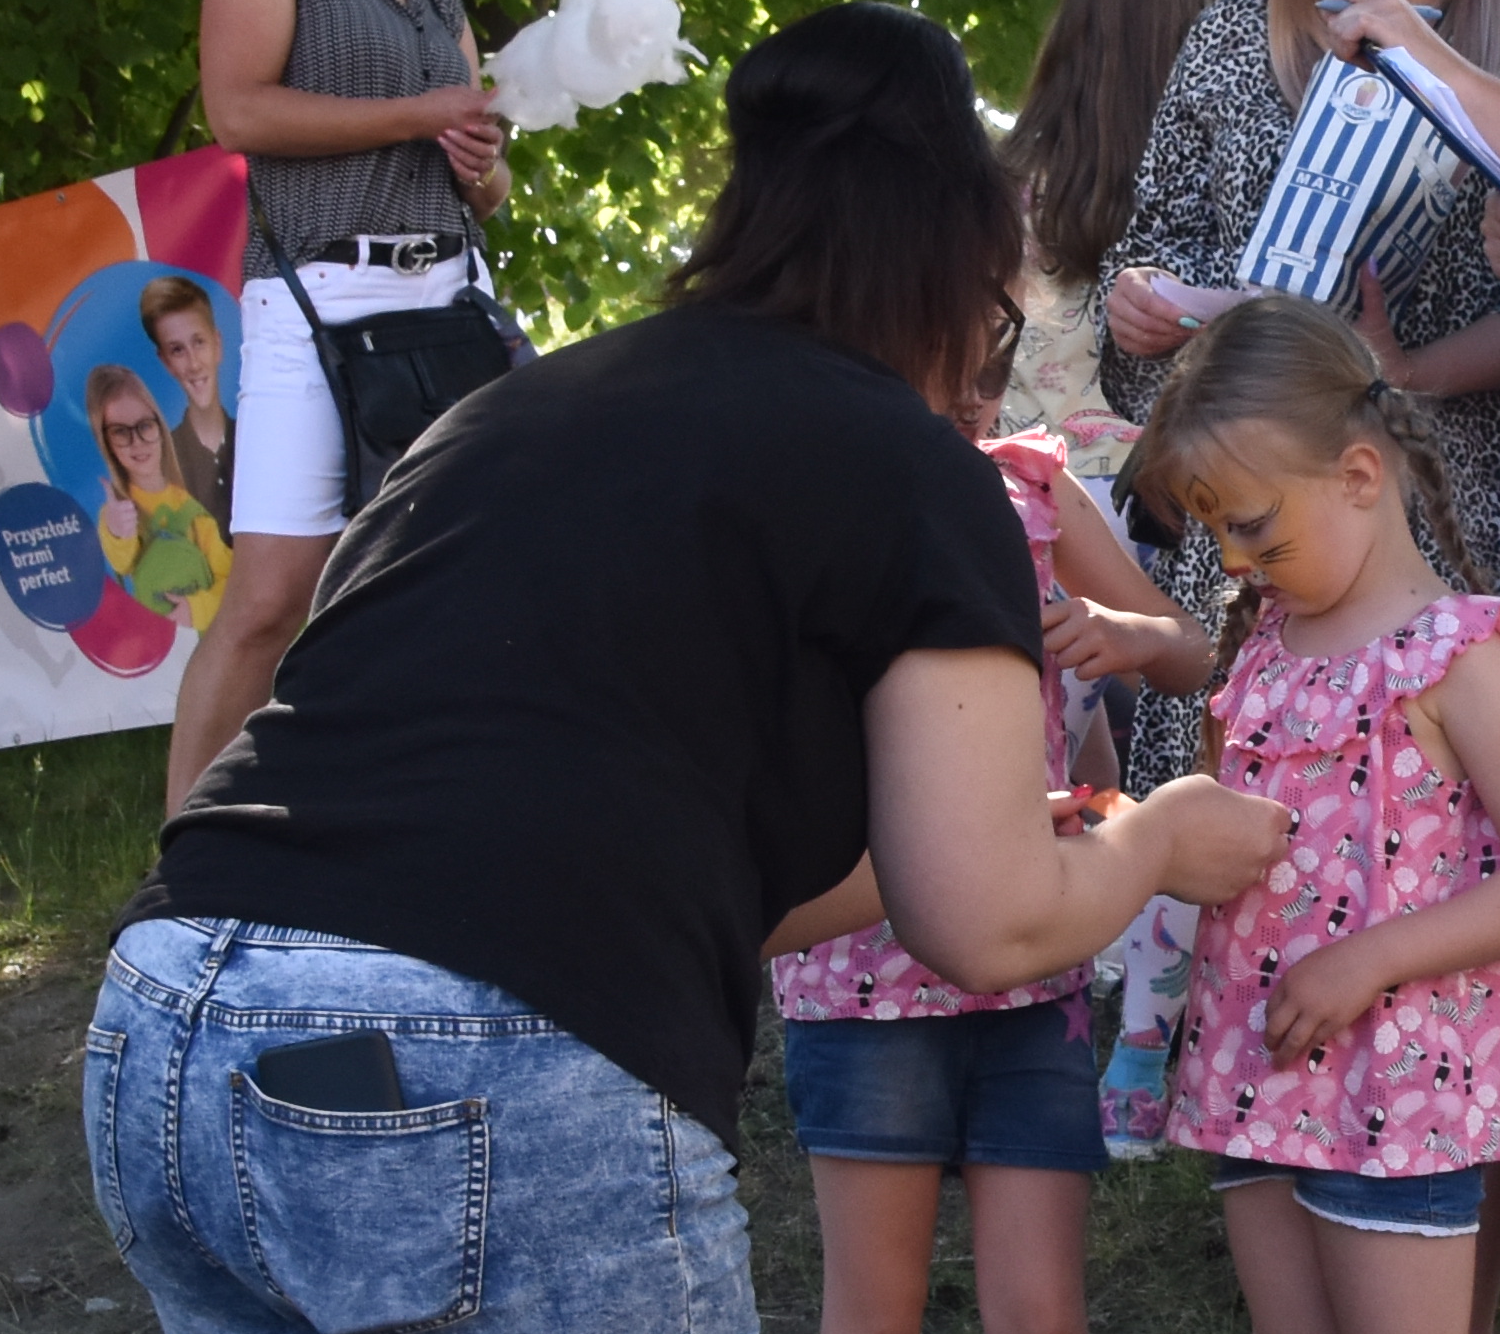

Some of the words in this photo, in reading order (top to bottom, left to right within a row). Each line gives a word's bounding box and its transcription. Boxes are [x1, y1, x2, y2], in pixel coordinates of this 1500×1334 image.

[1295, 170, 1350, 197] MAXI
[1, 514, 82, 548] Przyszłość
[10, 544, 55, 569] brzmi
[18, 566, 72, 597] perfect
